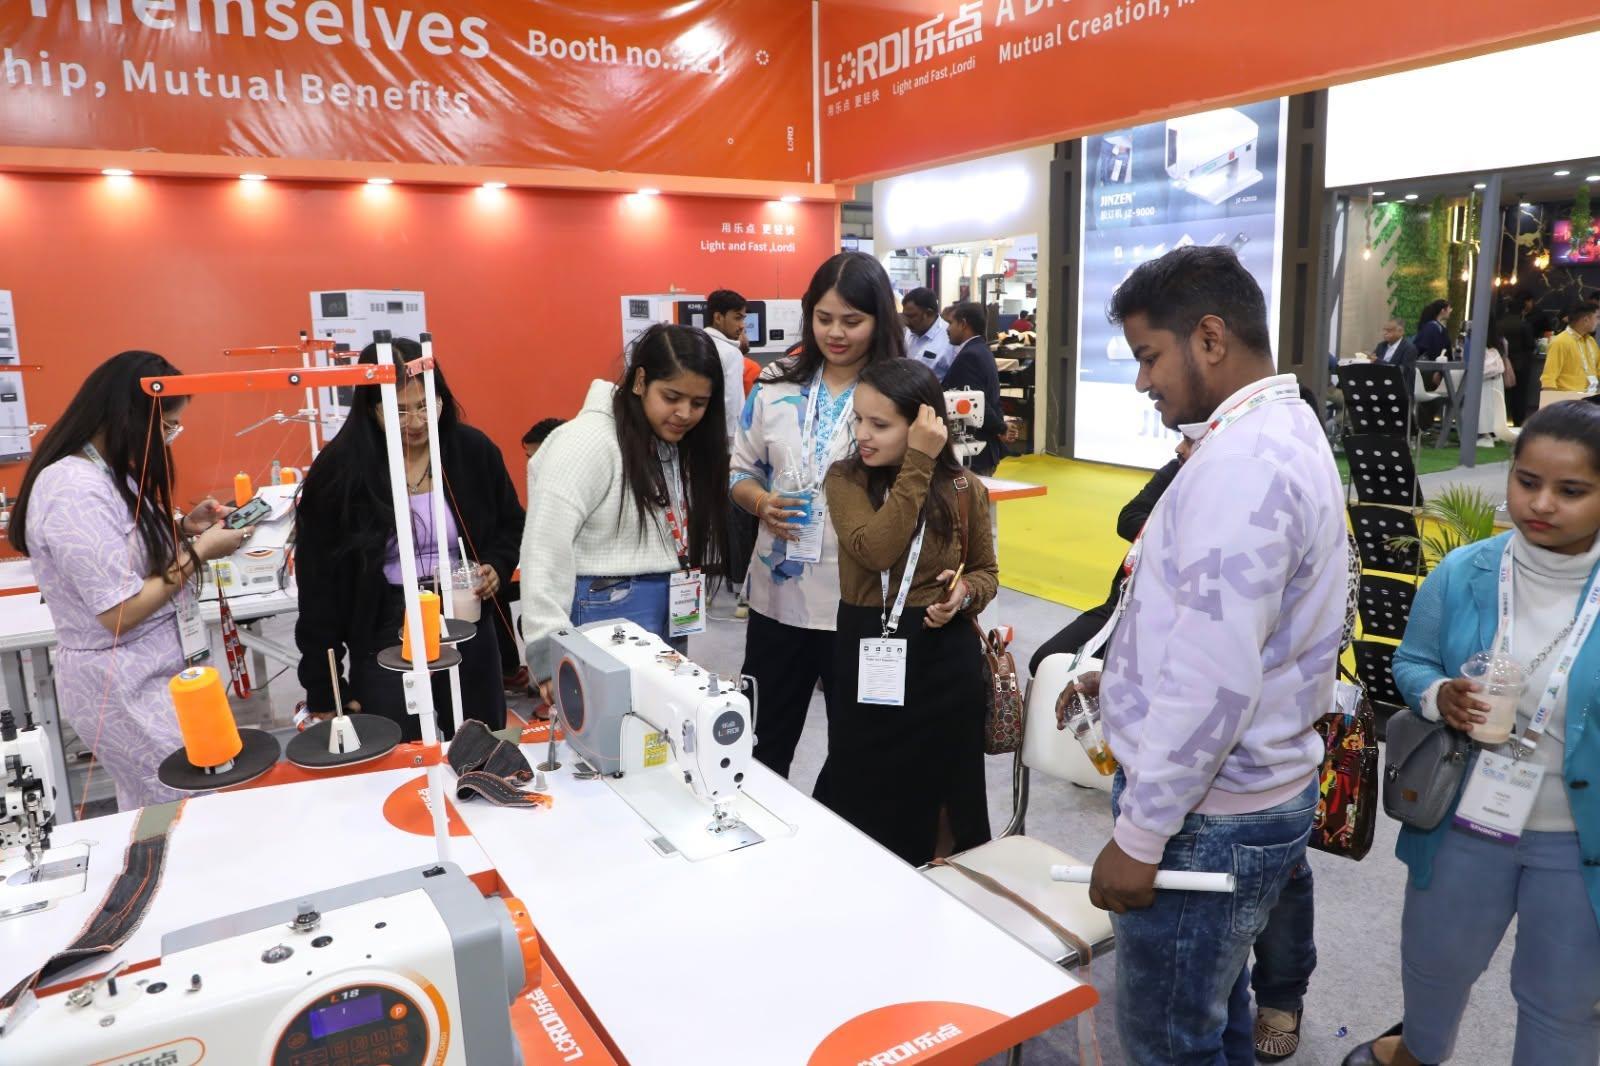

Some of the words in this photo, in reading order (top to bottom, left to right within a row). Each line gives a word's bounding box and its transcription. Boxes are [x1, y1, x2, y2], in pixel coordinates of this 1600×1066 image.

[31, 0, 490, 58] emselves
[528, 29, 617, 65] Booth
[999, 23, 1062, 64] Mutual
[1067, 0, 1170, 41] Creation,
[122, 59, 287, 103] Mutual
[301, 74, 471, 115] Benefits
[892, 79, 913, 96] Light
[914, 72, 929, 88] and
[930, 66, 949, 82] Fast
[700, 240, 726, 253] Light
[728, 241, 746, 252] and
[748, 242, 768, 252] Fast
